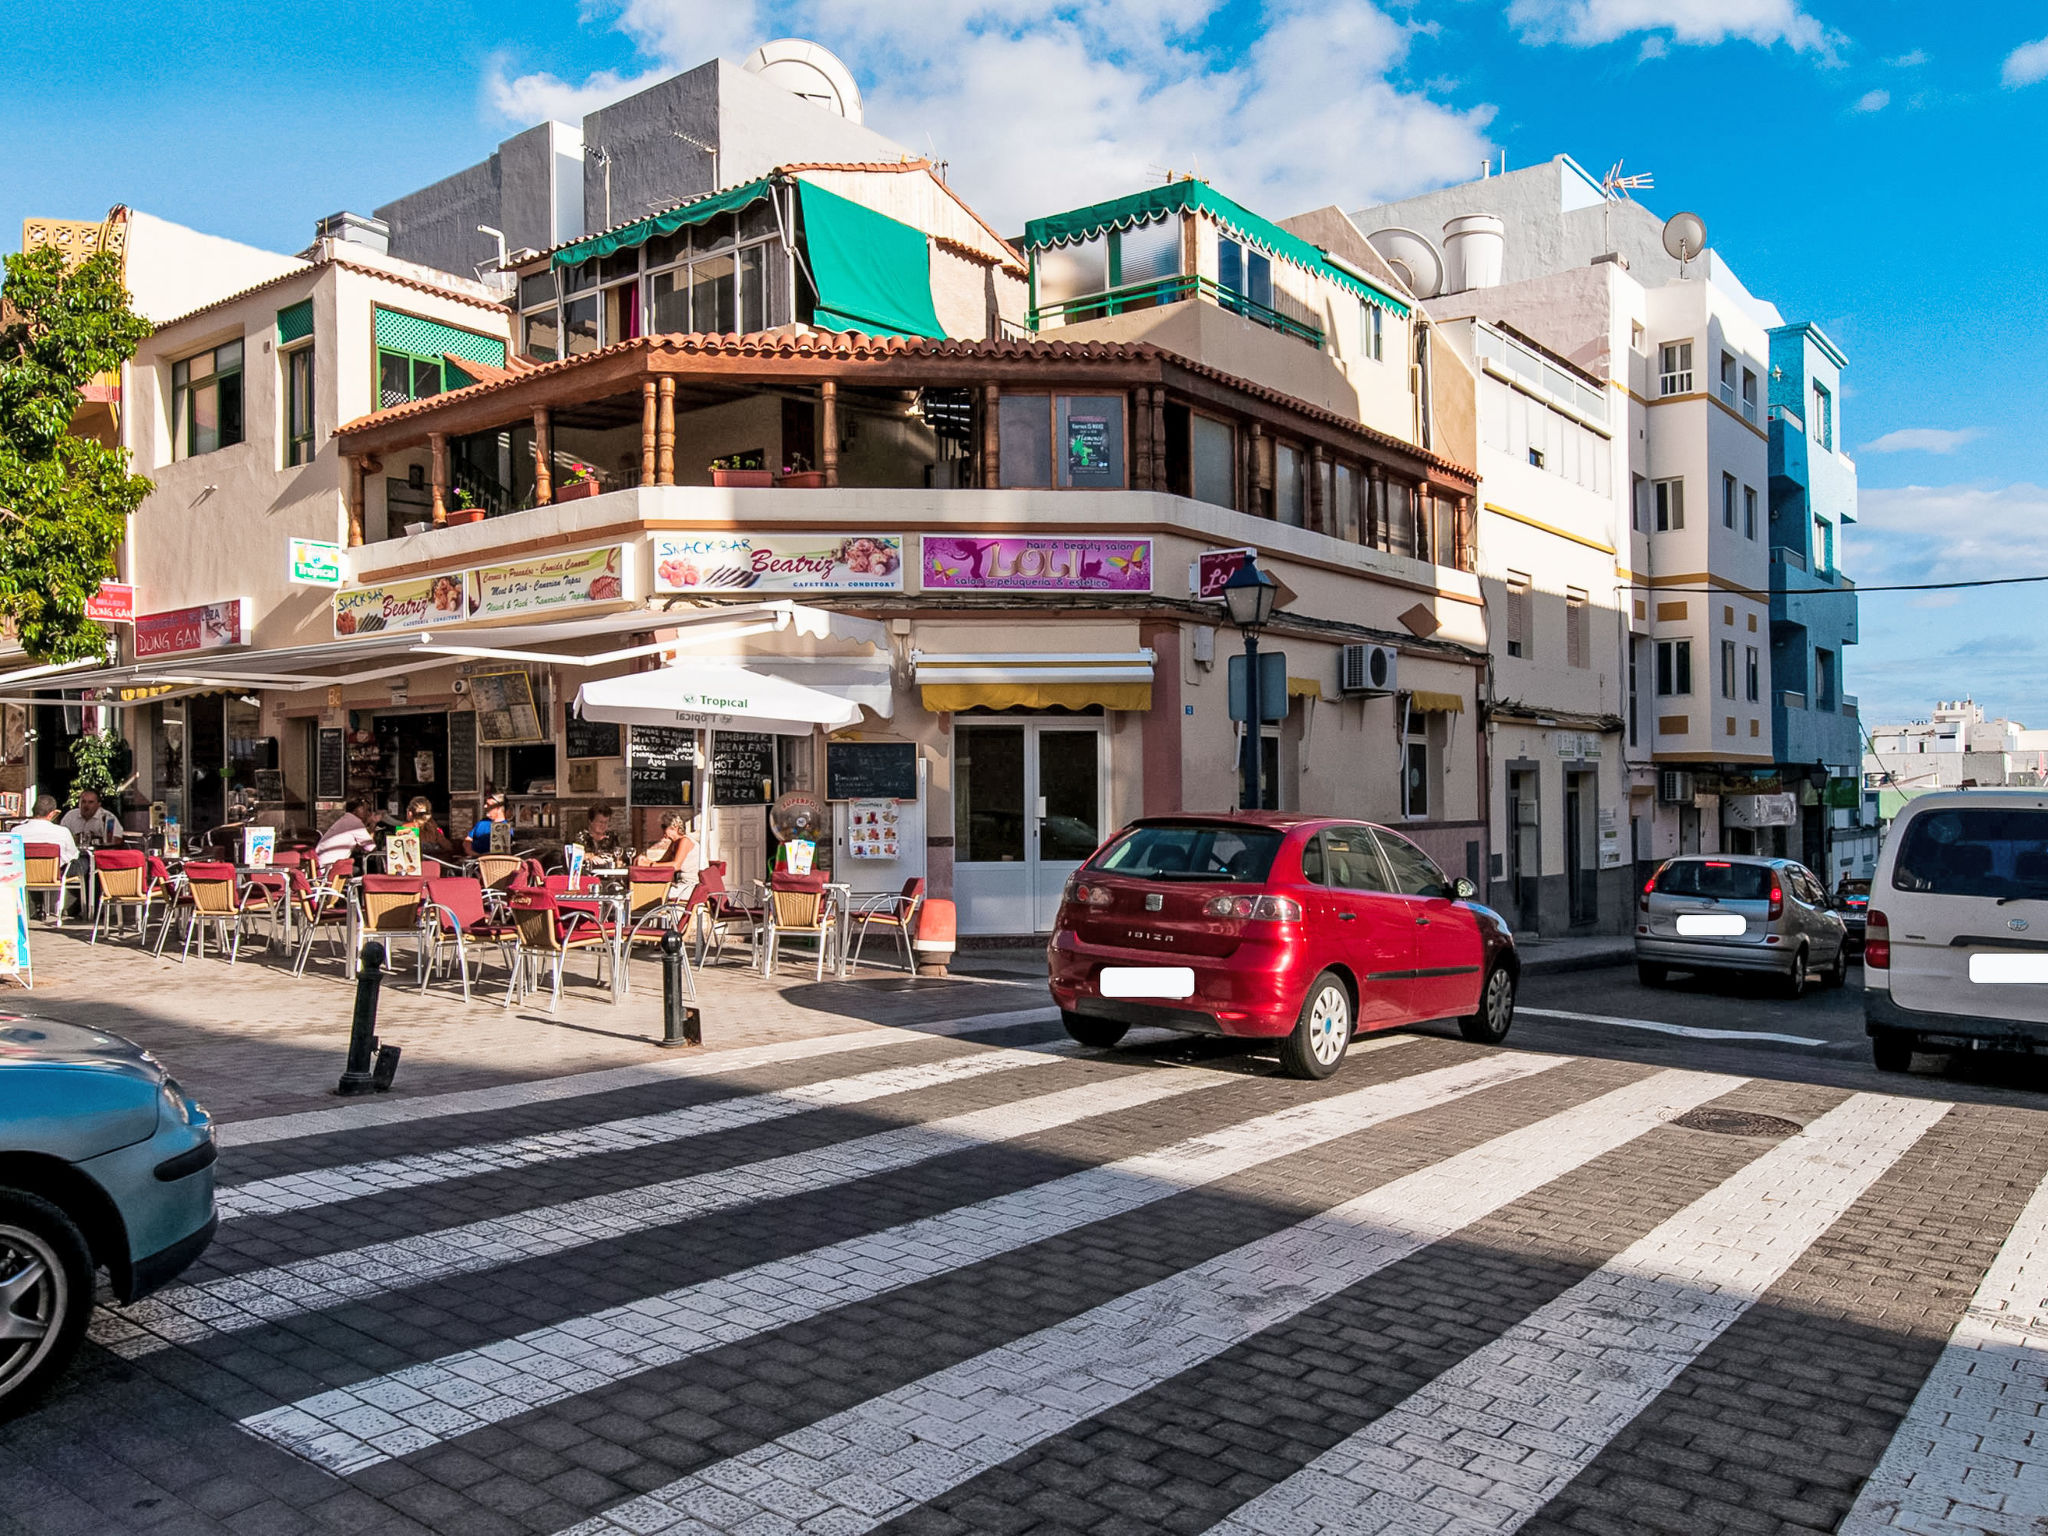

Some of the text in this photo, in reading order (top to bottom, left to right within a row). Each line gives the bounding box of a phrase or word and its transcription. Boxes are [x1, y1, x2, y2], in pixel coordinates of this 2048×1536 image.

[1027, 541, 1046, 550] hair
[1064, 541, 1100, 552] beauty
[1105, 542, 1133, 551] salon
[750, 549, 836, 580] Beatriz
[987, 542, 1081, 579] LOLI
[298, 563, 336, 579] Tropical
[514, 582, 527, 593] Fish
[89, 605, 114, 617] DONG
[383, 594, 429, 619] Beatriz
[138, 631, 170, 652] DONG
[700, 695, 748, 708] Tropical
[715, 760, 734, 769] HOT
[633, 770, 666, 780] PIZZA
[717, 788, 756, 799] PIZZA
[1128, 930, 1174, 942] IBIZA
